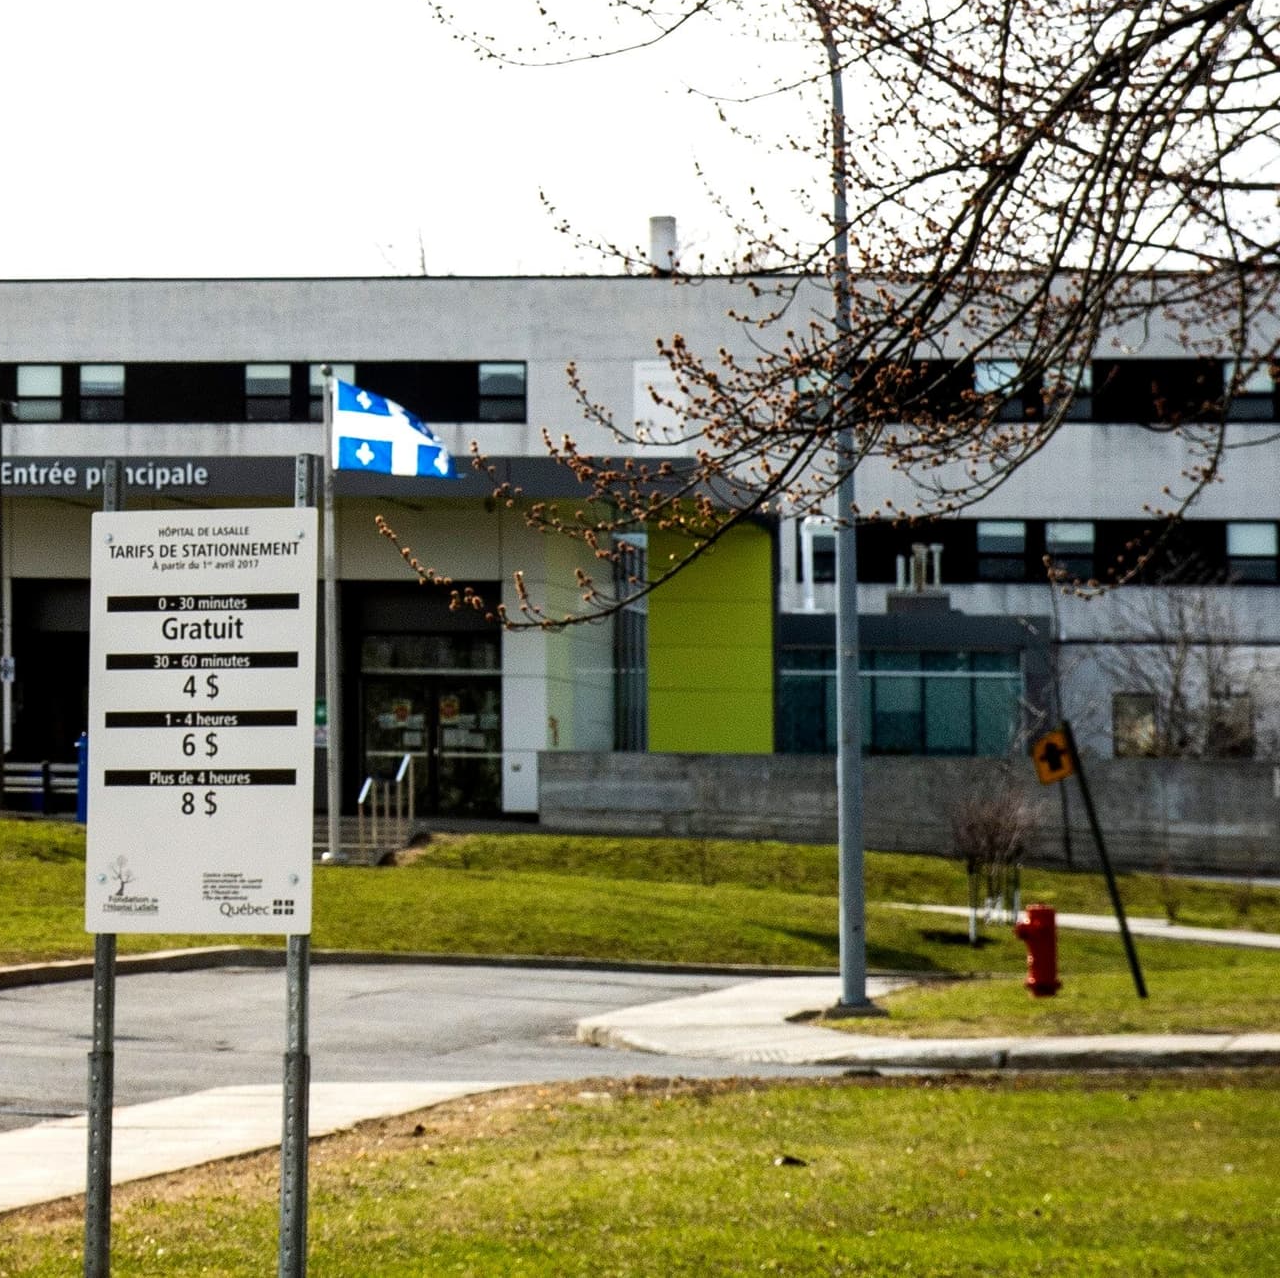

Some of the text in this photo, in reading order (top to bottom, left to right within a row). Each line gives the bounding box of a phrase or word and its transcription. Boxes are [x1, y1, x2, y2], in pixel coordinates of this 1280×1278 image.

[1, 461, 208, 490] Entrée pncipale
[158, 526, 249, 537] HÔPITAL DE LASALLE
[110, 542, 300, 558] TARIFS DE STATIONNEMENT
[161, 561, 185, 572] partir
[188, 561, 200, 570] du
[215, 560, 235, 569] avril
[237, 559, 259, 568] 2017
[158, 597, 167, 610] 0
[179, 597, 195, 610] 30
[198, 596, 248, 610] minutes
[162, 616, 244, 640] Gratuit
[154, 655, 169, 668] 30
[181, 655, 198, 667] 60
[201, 654, 250, 667] minutes
[183, 673, 219, 700] 4 $
[165, 714, 171, 726] 1
[184, 713, 192, 725] 4
[196, 712, 238, 726] heures
[182, 732, 218, 759] 6 $
[149, 771, 251, 785] Plus de 4 heures
[181, 790, 217, 818] 8 $
[220, 902, 270, 917] Québec
